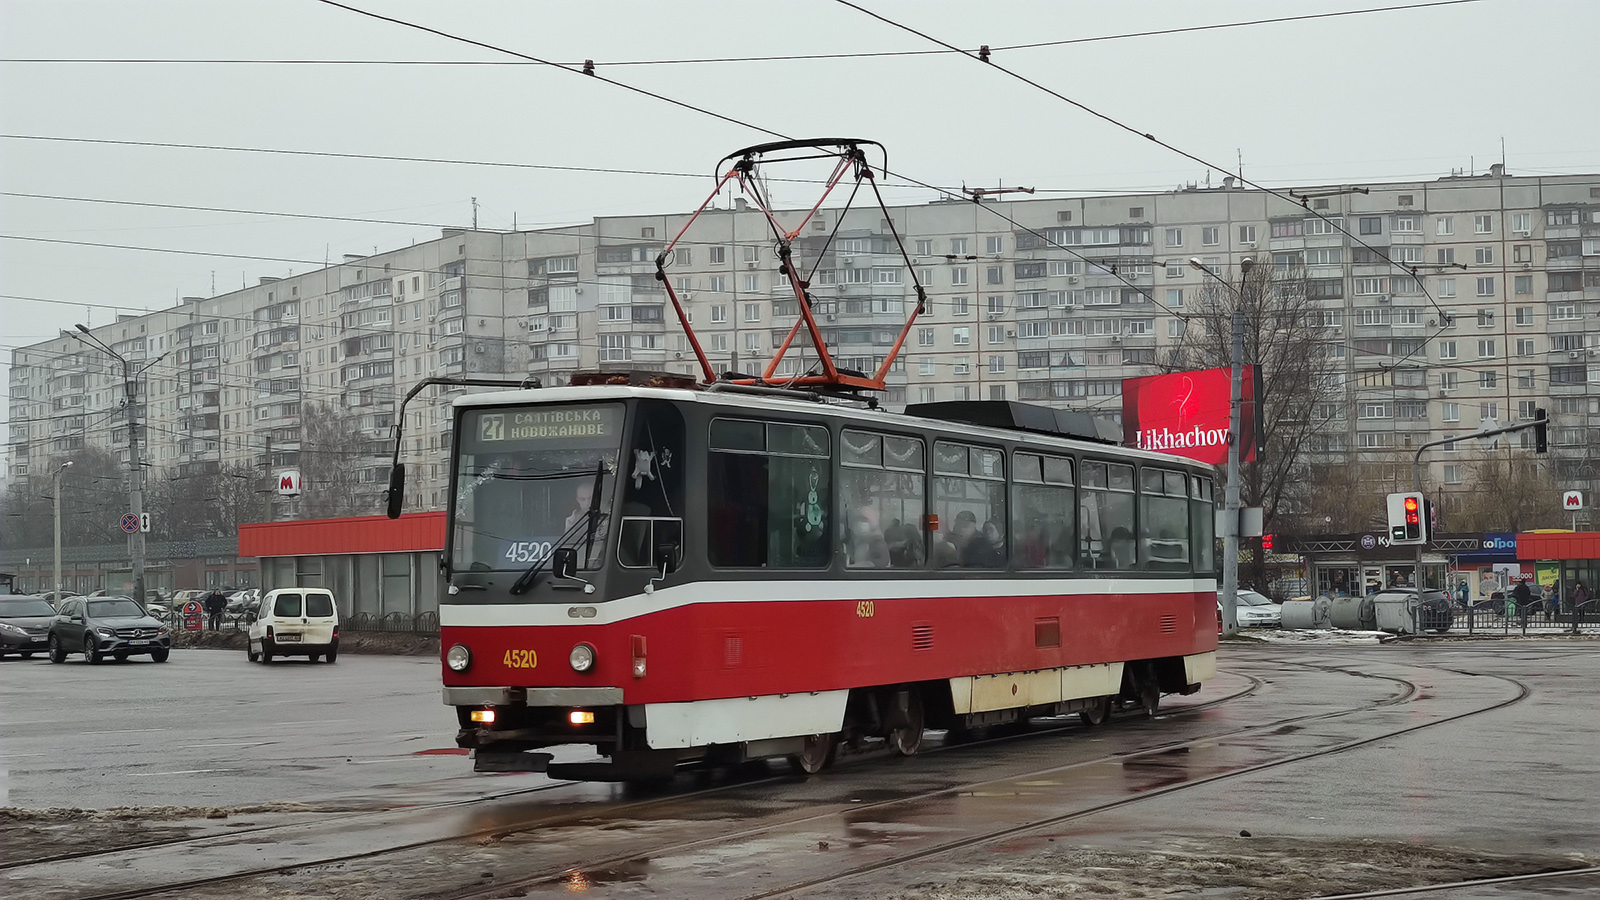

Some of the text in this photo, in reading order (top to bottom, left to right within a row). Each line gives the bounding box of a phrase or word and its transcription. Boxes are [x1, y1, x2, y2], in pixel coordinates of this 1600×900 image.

[482, 415, 504, 440] 27
[511, 423, 605, 438] НОВОЖАНОВЕ
[1136, 426, 1231, 451] Likhachov
[505, 541, 552, 562] 4520
[856, 600, 875, 618] 4520
[503, 649, 538, 669] 4520
